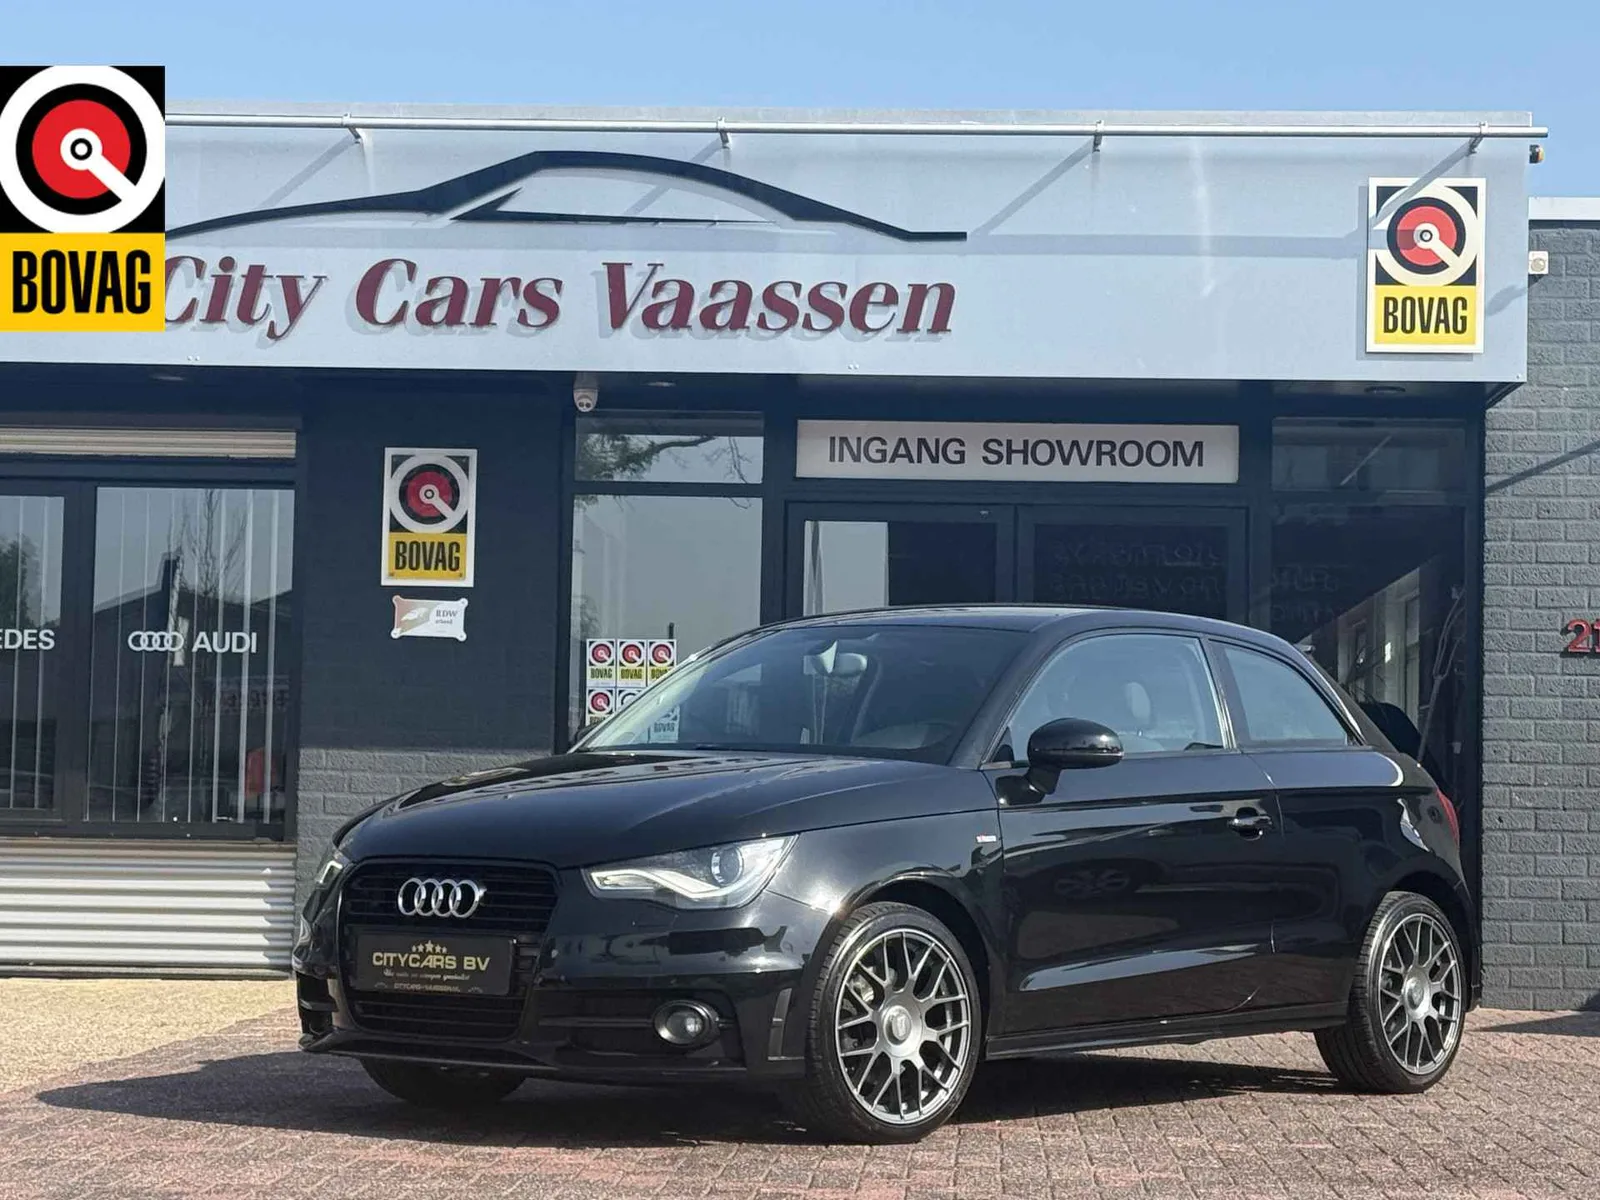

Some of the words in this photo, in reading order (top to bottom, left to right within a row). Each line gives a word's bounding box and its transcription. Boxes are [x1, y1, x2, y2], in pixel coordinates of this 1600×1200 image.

[165, 255, 326, 340] City
[356, 258, 563, 328] Cars
[601, 261, 956, 335] Vaassen
[1383, 296, 1468, 334] BOVAG
[828, 435, 966, 465] INGANG
[981, 438, 1205, 468] SHOWROOM
[395, 540, 461, 572] BOVAG
[0, 629, 55, 650] DES
[191, 631, 257, 653] AUDI
[590, 668, 613, 679] BOVAG
[620, 668, 643, 679] BOVAG
[372, 952, 457, 970] CITYCARS
[463, 956, 490, 971] BV
